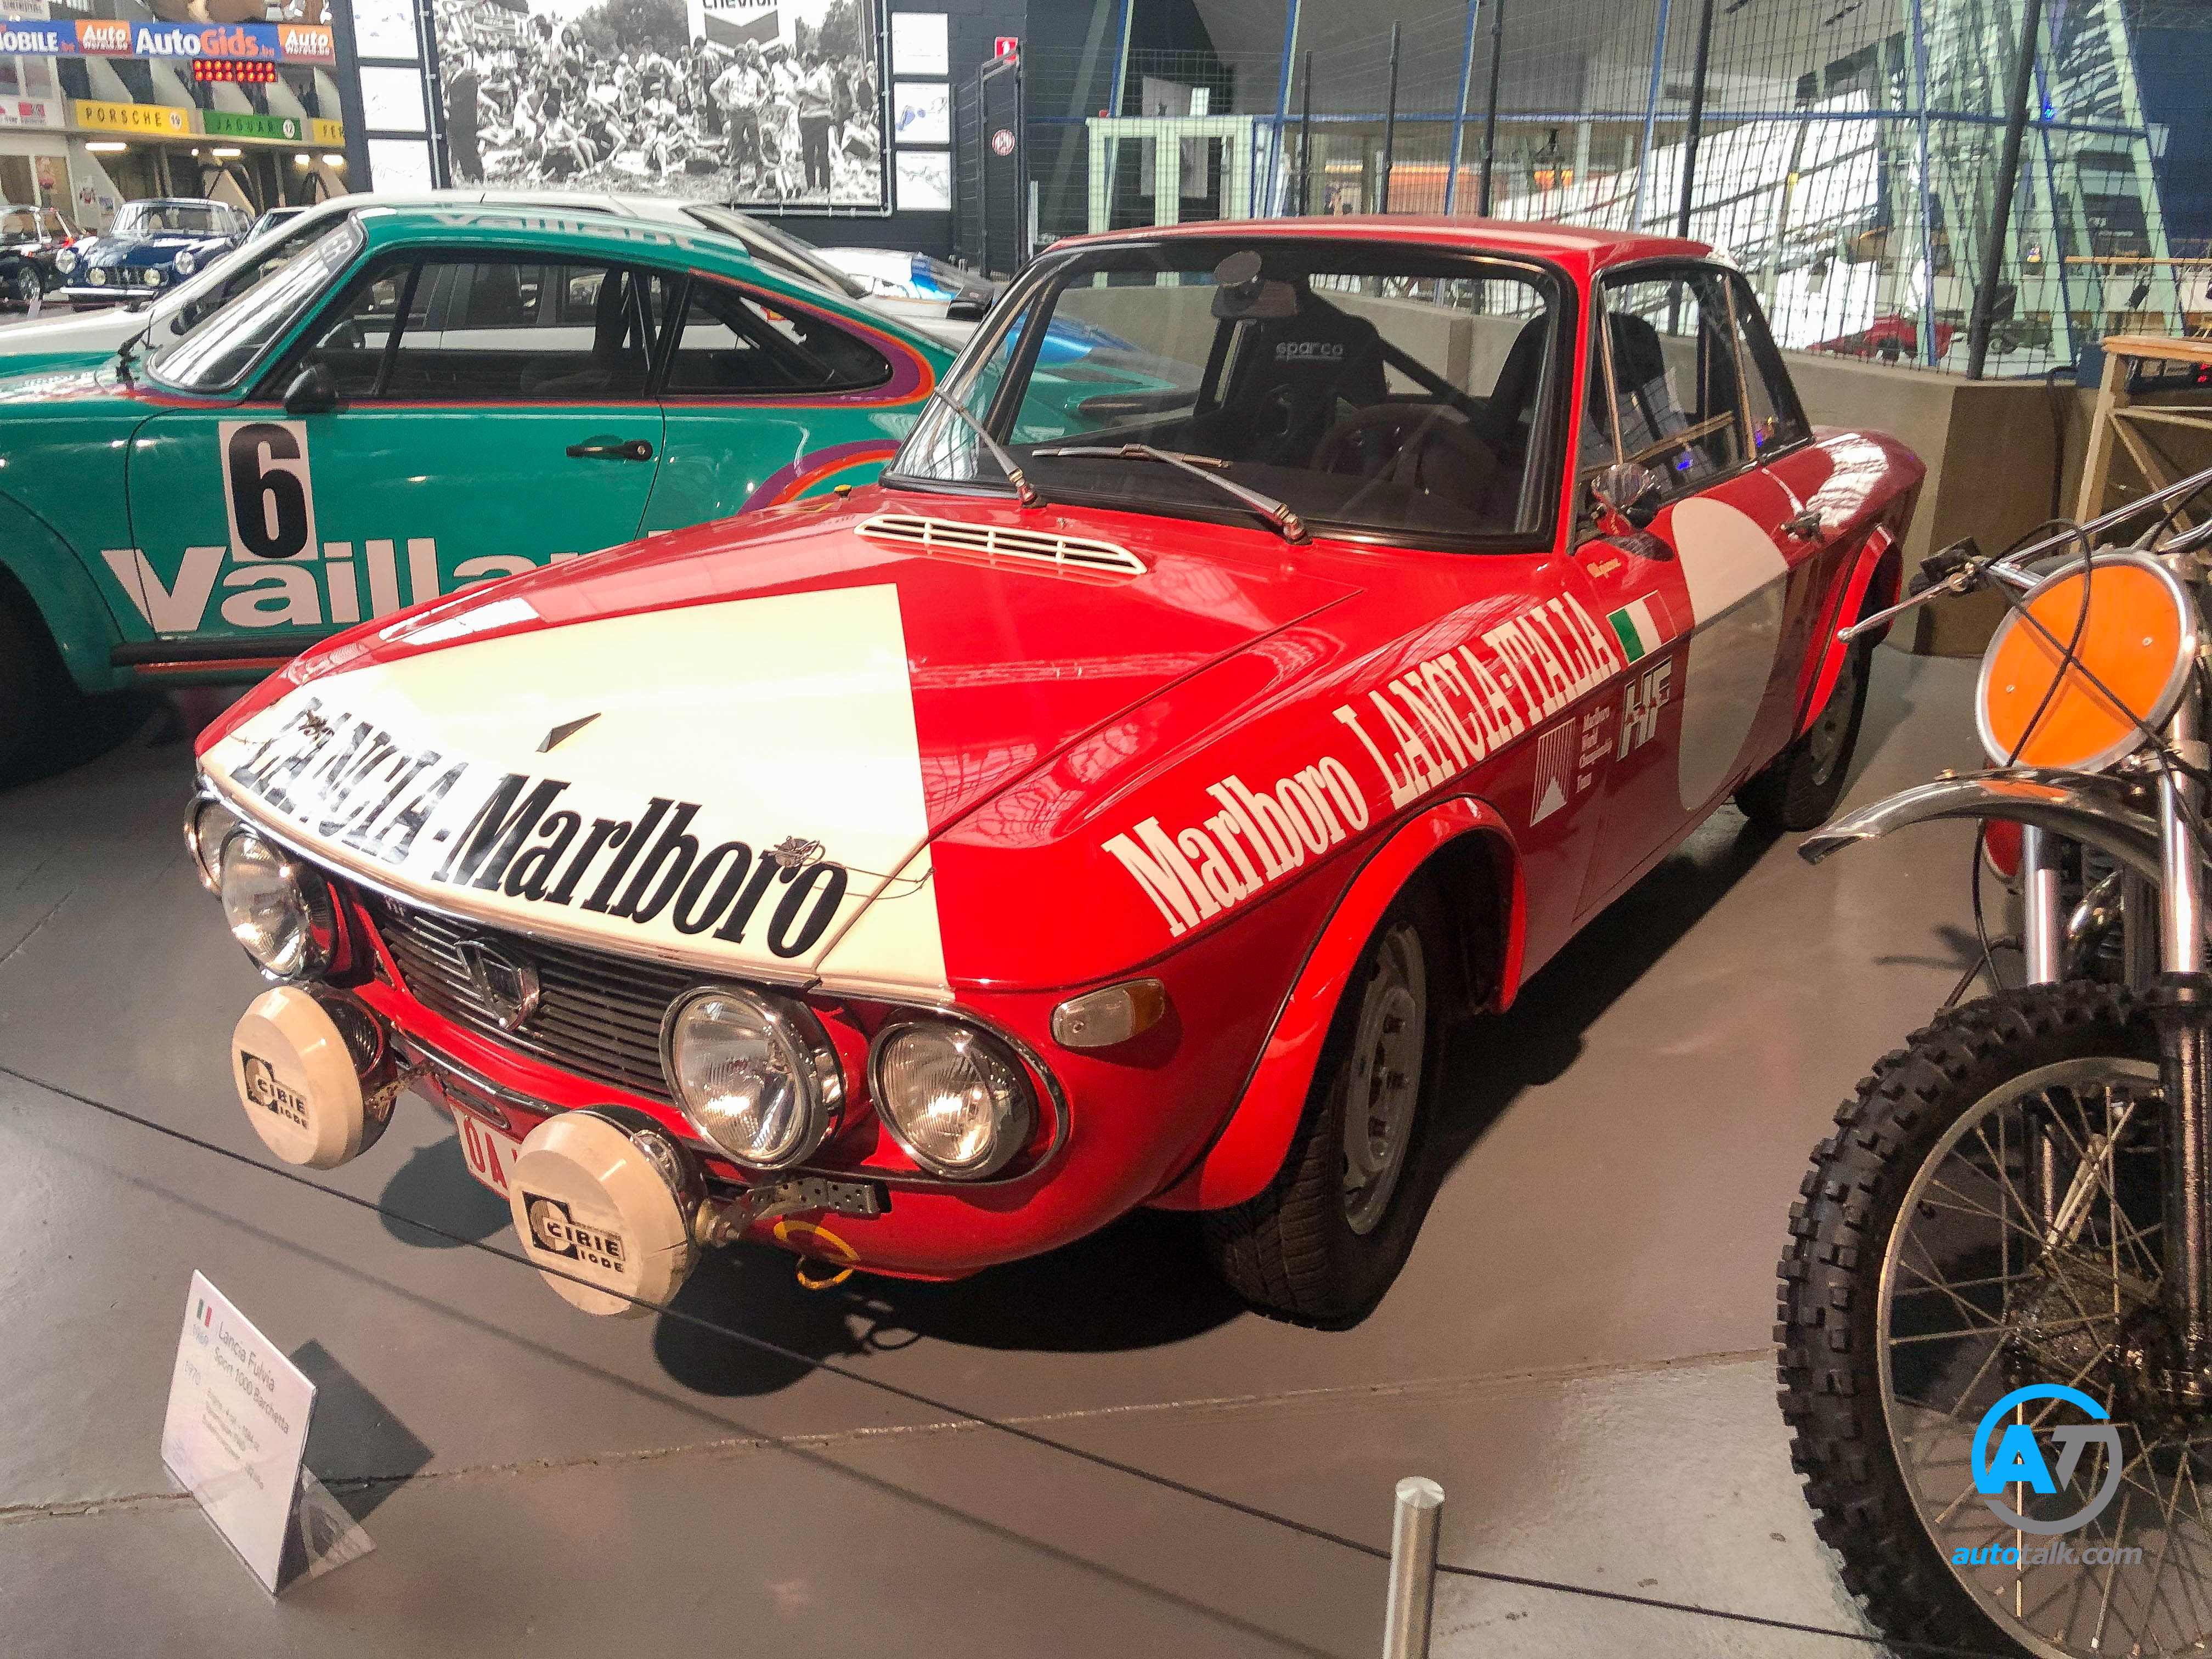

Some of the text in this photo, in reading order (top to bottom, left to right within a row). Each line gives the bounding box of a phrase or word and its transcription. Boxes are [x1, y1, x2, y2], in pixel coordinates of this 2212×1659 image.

[83, 24, 127, 42] Auto
[285, 29, 329, 46] Auto
[85, 107, 162, 128] PORSCHE
[1276, 341, 1345, 362] sparco
[228, 422, 308, 559] 6
[1616, 655, 1673, 762] HF
[1101, 756, 1370, 939] Marlboro
[257, 1078, 306, 1115] CIBIE
[464, 1117, 518, 1190] OA
[547, 1221, 620, 1257] CIBIE
[580, 1250, 624, 1273] IODE
[219, 1321, 246, 1363] Lancia
[249, 1351, 275, 1392] Fulvia
